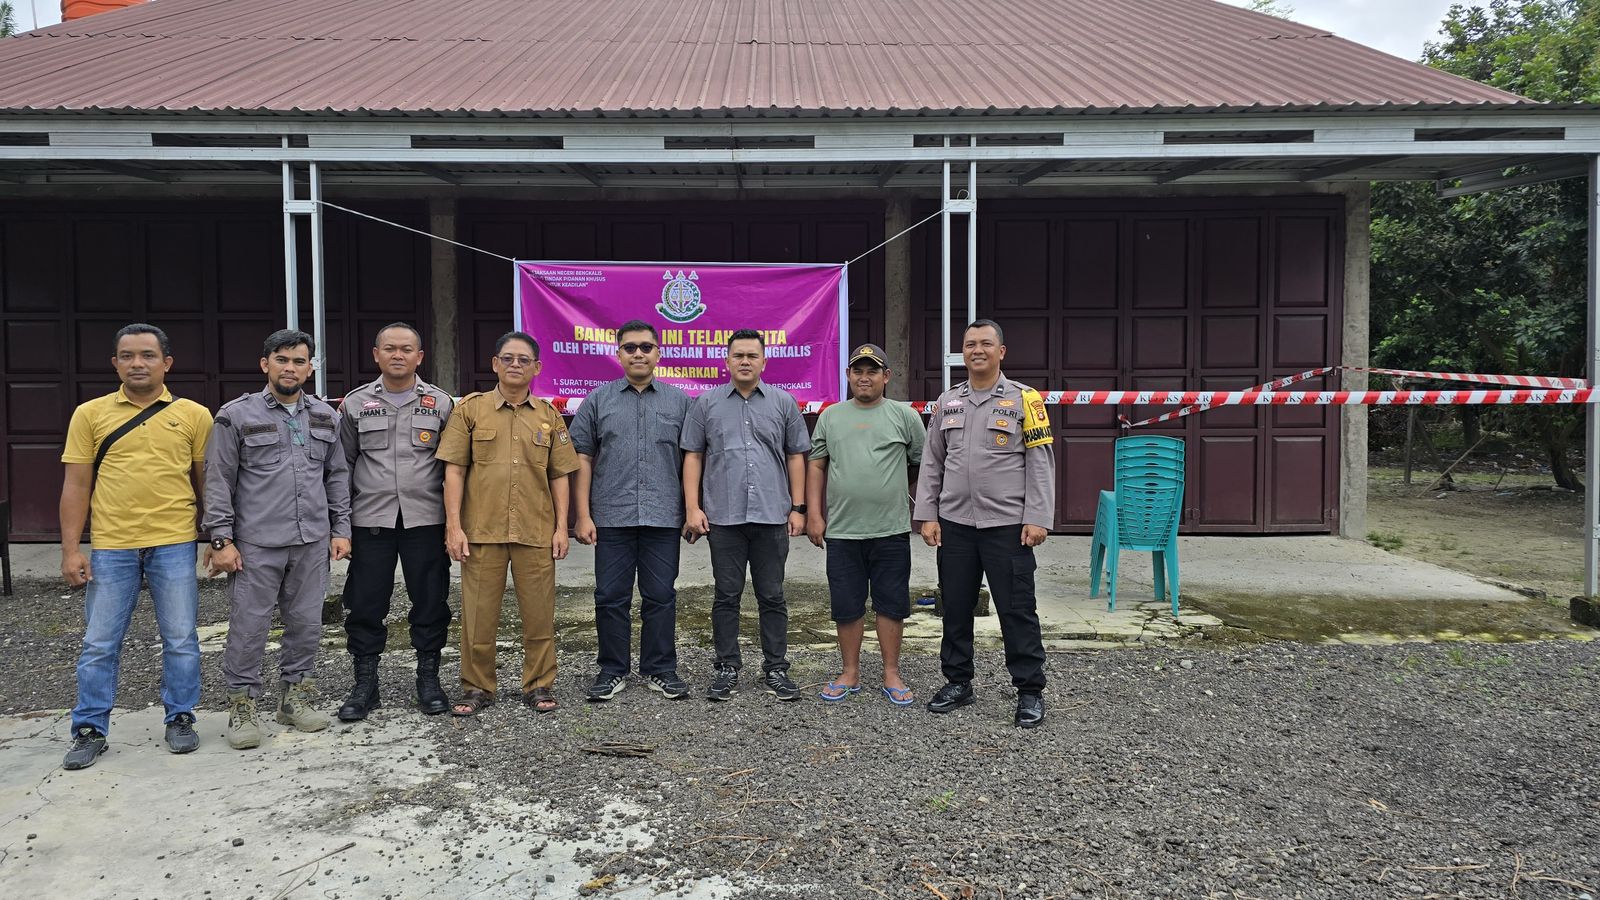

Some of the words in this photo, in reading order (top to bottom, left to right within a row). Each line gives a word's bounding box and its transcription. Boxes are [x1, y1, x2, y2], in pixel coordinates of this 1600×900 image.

[661, 329, 683, 345] INI
[552, 341, 579, 354] OLEH
[764, 345, 811, 358] NGKALIS
[559, 378, 583, 386] SURAT
[559, 387, 587, 395] NOMOR
[1080, 394, 1091, 402] RI
[415, 408, 440, 416] POLRI
[993, 408, 1018, 419] POLRI
